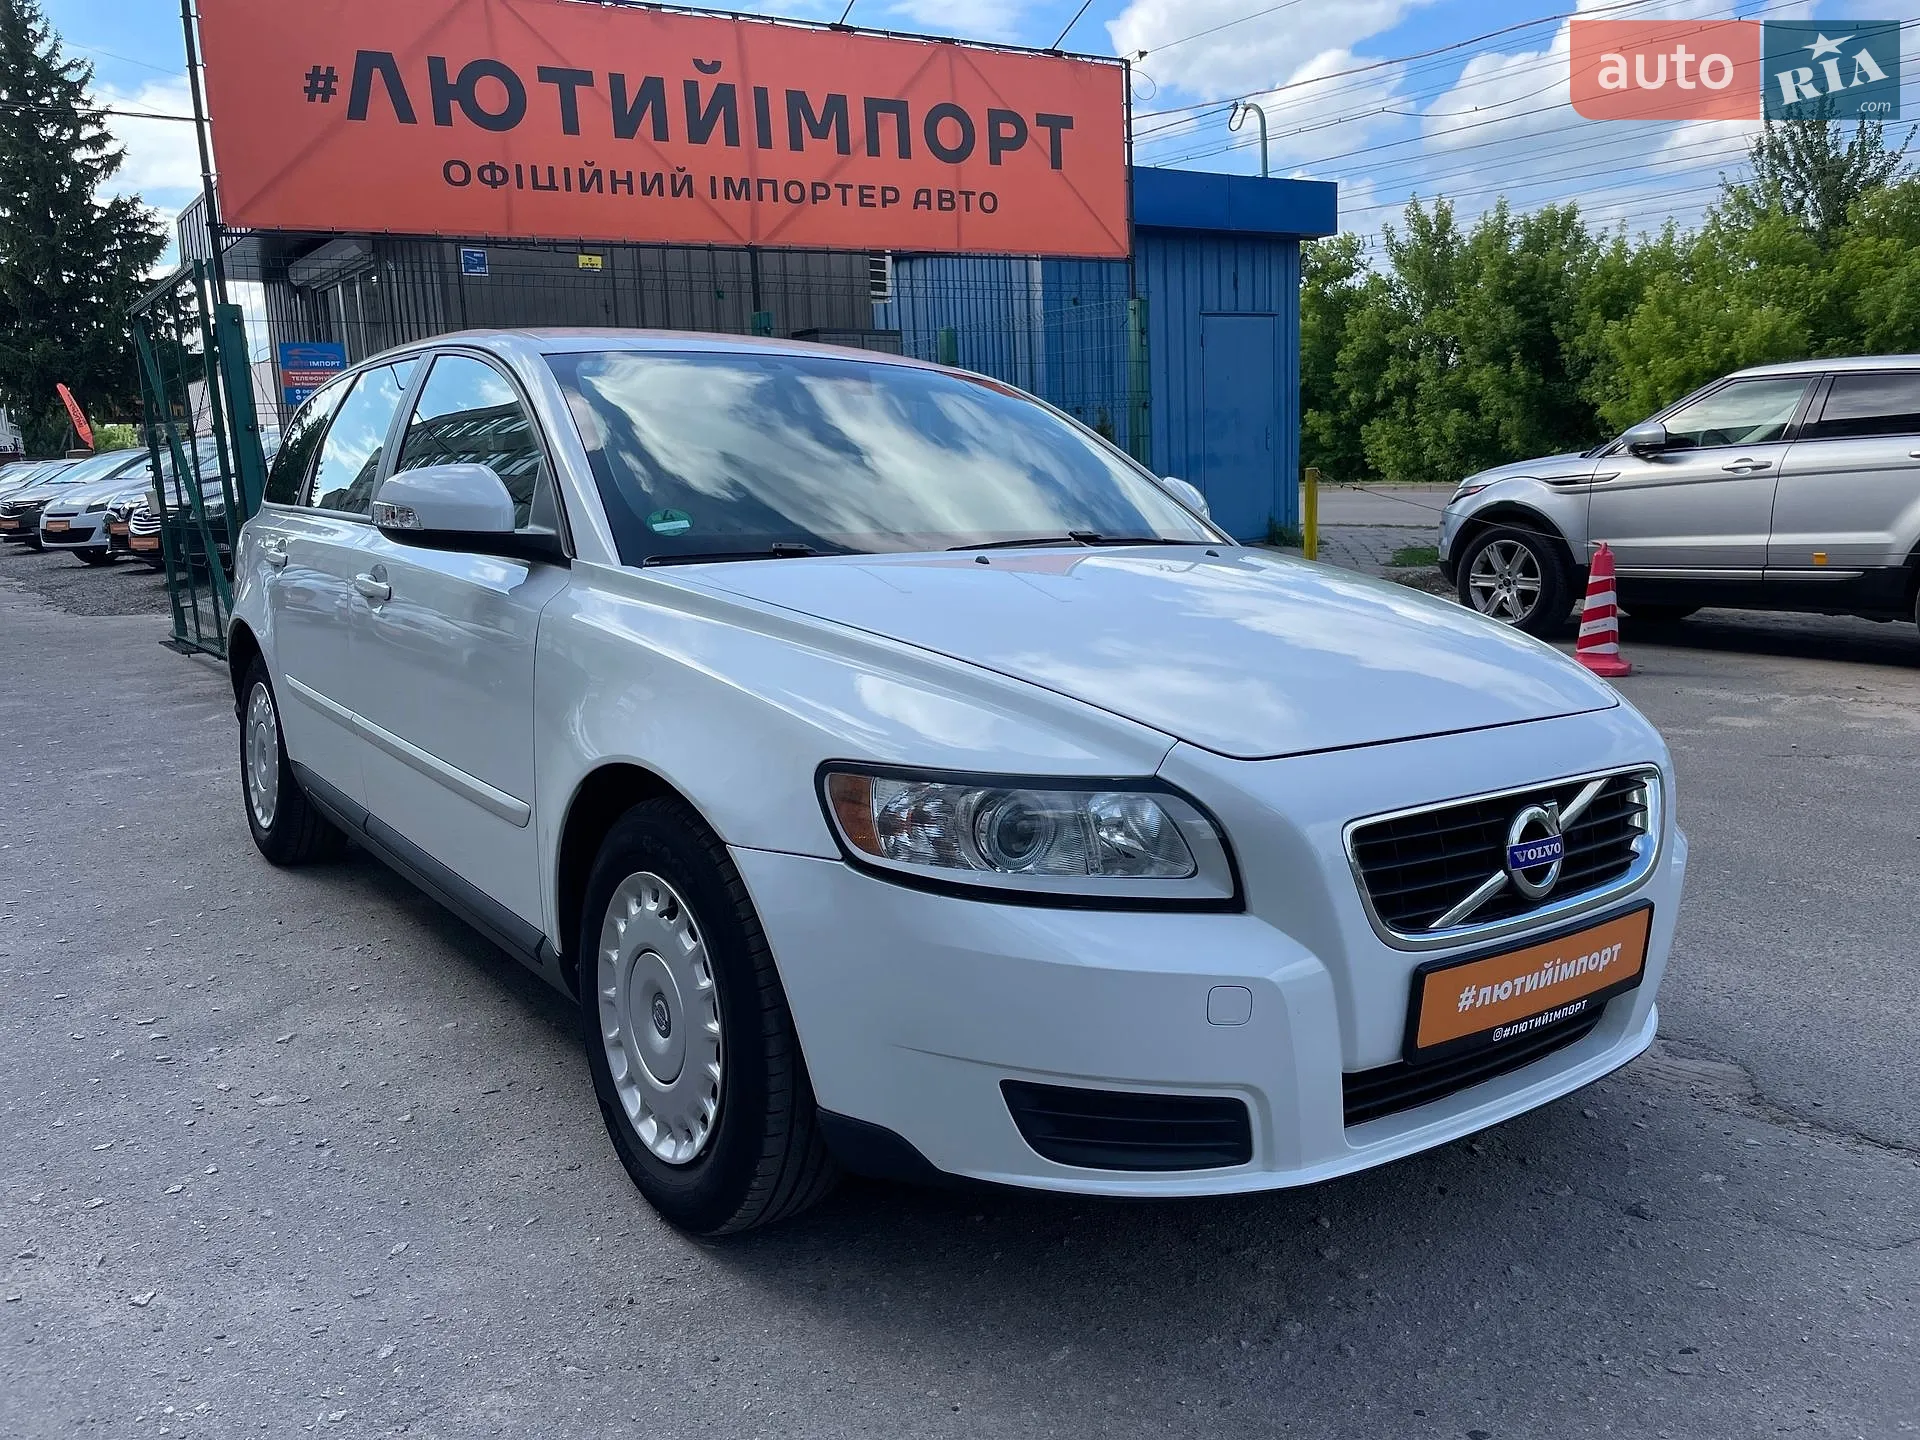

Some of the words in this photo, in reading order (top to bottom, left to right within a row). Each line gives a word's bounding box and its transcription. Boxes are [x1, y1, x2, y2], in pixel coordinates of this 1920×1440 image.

[303, 49, 1074, 171] #ЛЮТИЙІМПОРТ
[442, 158, 694, 199] ОФІЦІЙНИЙ
[710, 175, 900, 209] ІМПОРТЕР
[912, 188, 999, 214] АВТО
[1513, 842, 1561, 863] VOLVO
[1457, 942, 1622, 1013] #лютийімпорт
